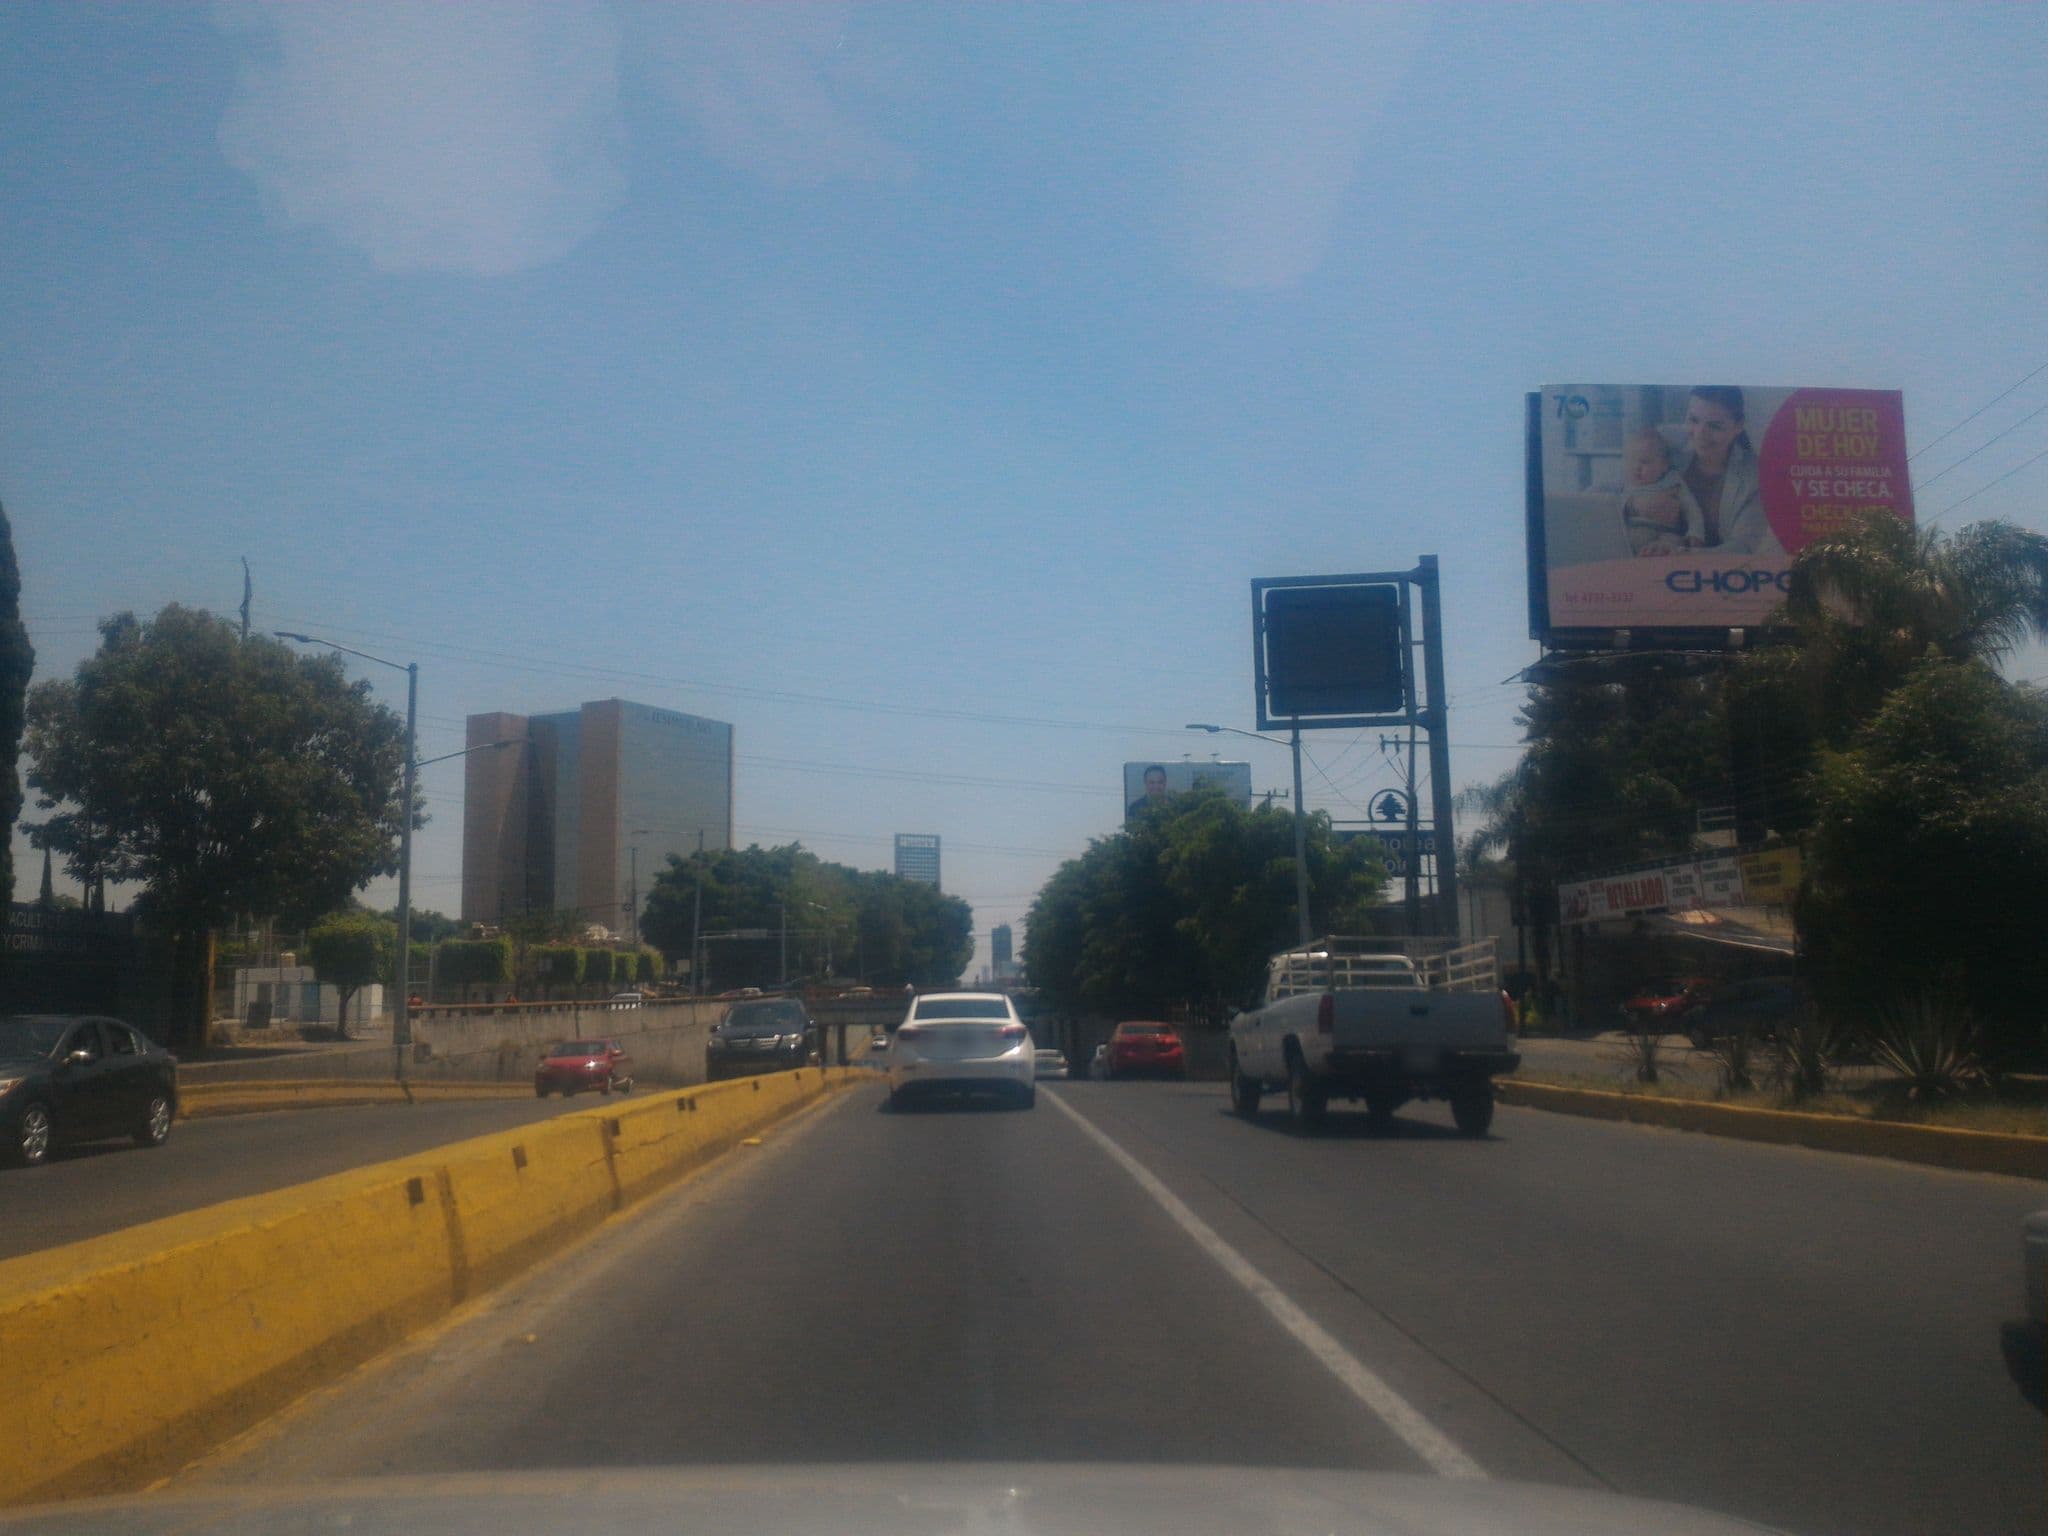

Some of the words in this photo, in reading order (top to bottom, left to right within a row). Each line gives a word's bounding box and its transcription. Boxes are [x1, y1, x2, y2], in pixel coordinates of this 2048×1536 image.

[1795, 407, 1878, 433] MUJER
[1796, 433, 1829, 457] DE
[1834, 433, 1879, 457] HOY
[1791, 479, 1802, 496] Y
[1808, 480, 1830, 496] SE
